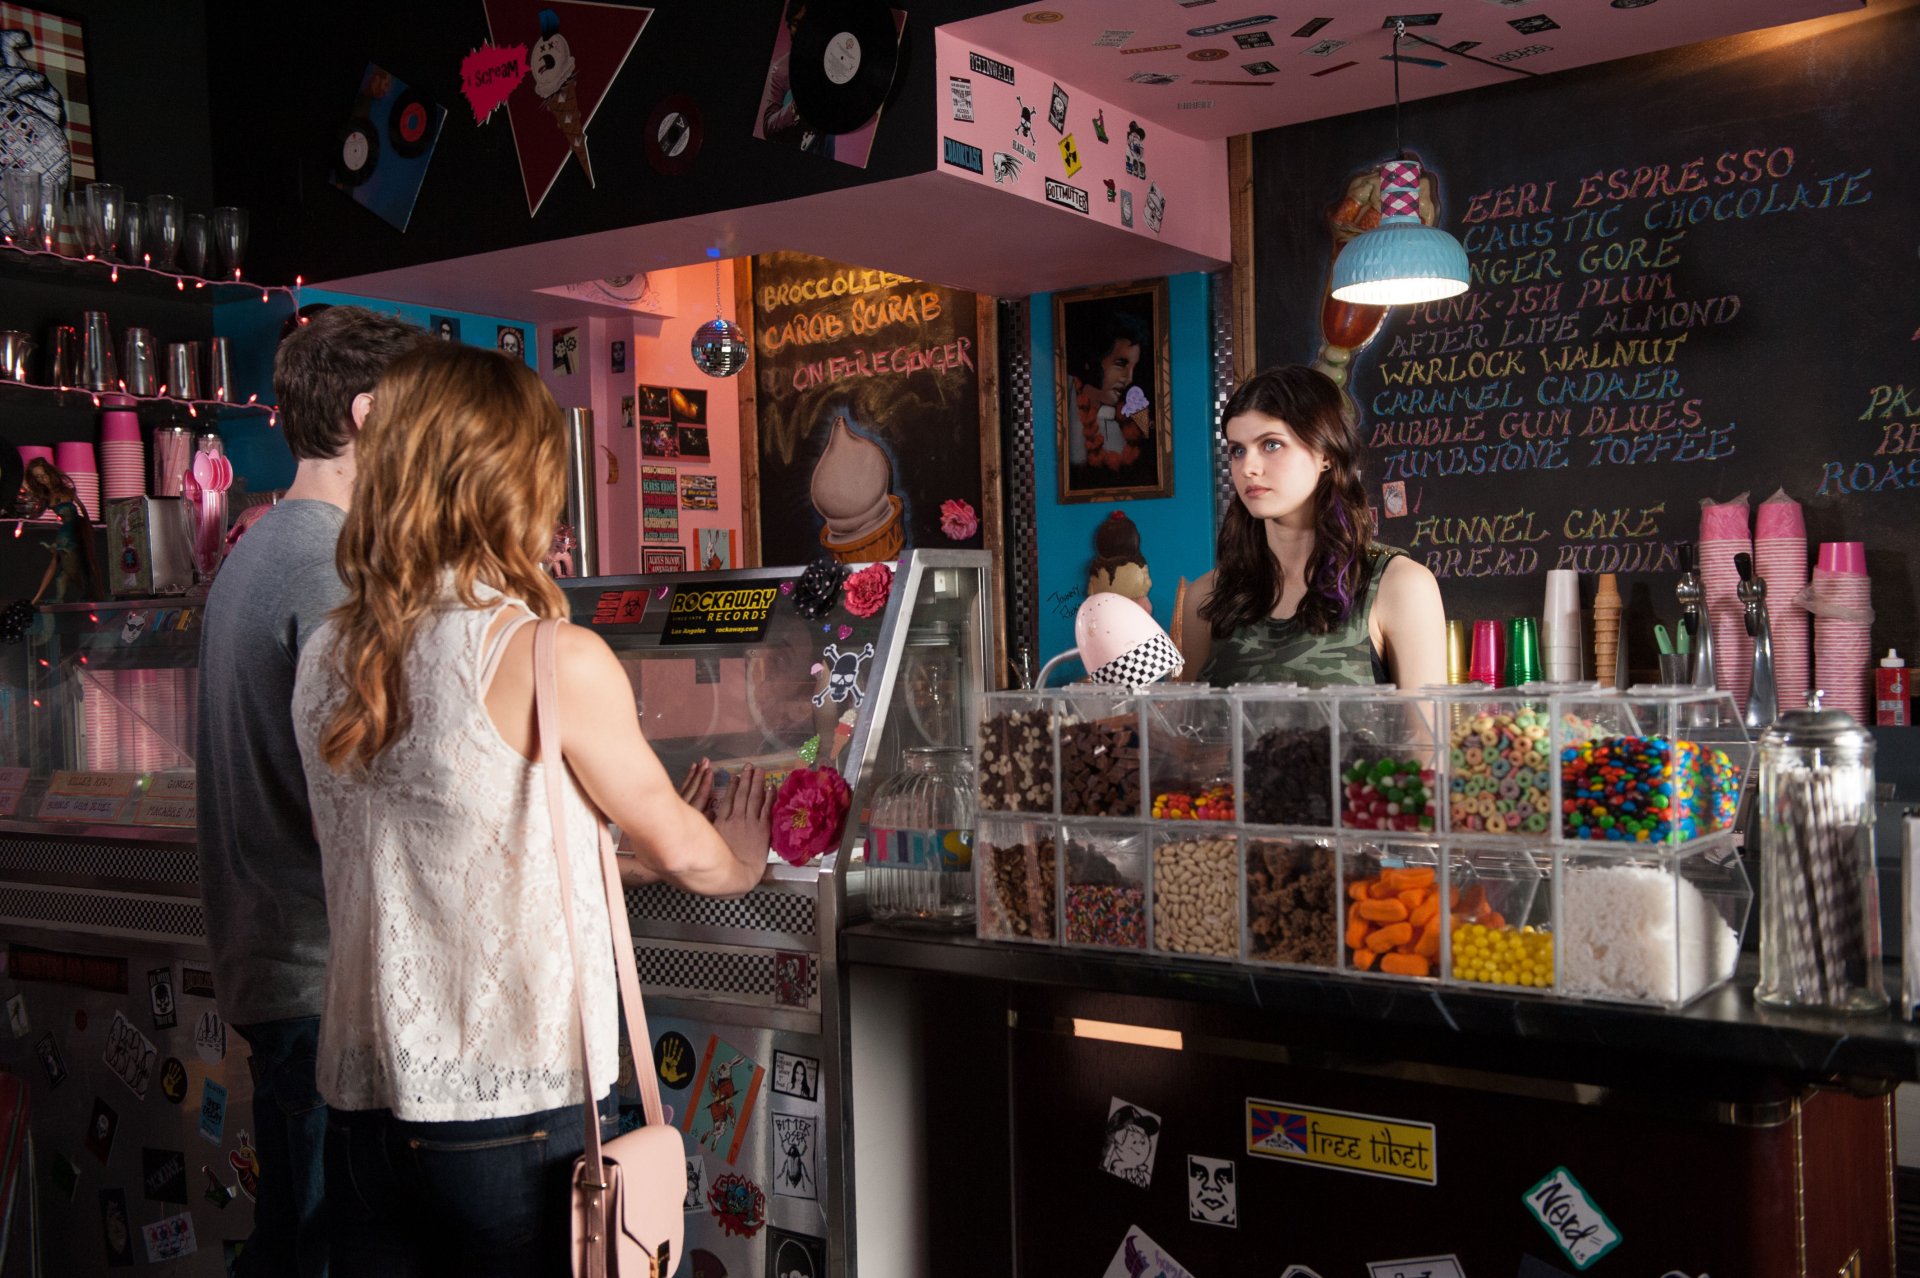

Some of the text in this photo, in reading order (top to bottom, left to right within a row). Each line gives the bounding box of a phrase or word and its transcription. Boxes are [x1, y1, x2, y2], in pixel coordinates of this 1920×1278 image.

[970, 54, 1014, 84] THINWALL
[1462, 147, 1794, 223] EERI ESPRESSO
[1462, 168, 1873, 254] CAUSTIC CHOCOLATE
[1579, 230, 1687, 274] GORE
[1576, 271, 1676, 310] PLUM
[765, 291, 943, 350] CAROB SCARAB
[1387, 294, 1742, 359] AFTER LIFE ALMOND
[792, 361, 824, 392] ON
[1379, 331, 1688, 386] WARLOCK WALNUT
[1372, 380, 1523, 417] CARAMEL
[1368, 398, 1703, 449] BUBBLE GUM BLUES
[1587, 421, 1736, 468] TOFFEE
[1409, 502, 1665, 547] FUNNEL CAKE
[1424, 540, 1691, 579] BREAD PUDDIN
[671, 588, 777, 613] ROCKAWAY
[707, 610, 767, 622] RECORDS
[715, 626, 759, 635] rockaway.com
[775, 1119, 812, 1136] BITTER
[1311, 1120, 1429, 1171] free tibet
